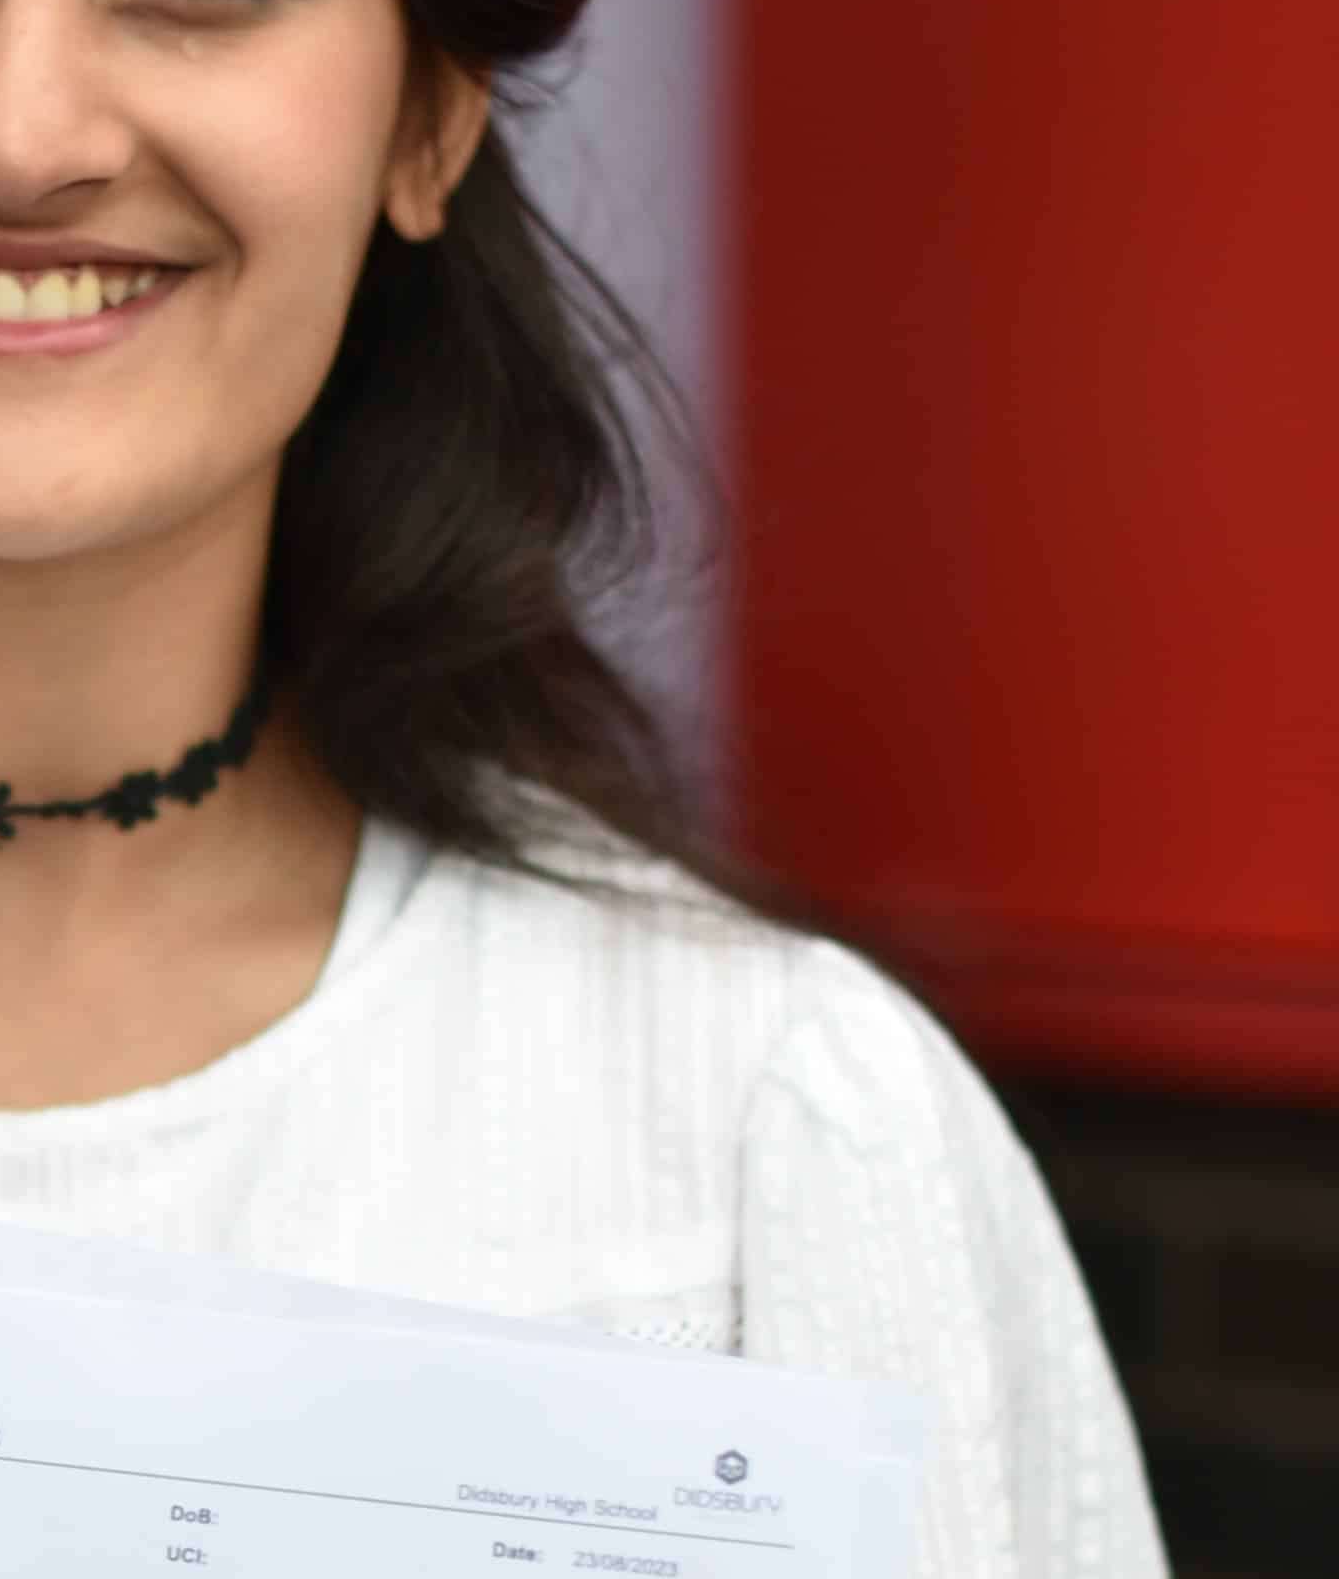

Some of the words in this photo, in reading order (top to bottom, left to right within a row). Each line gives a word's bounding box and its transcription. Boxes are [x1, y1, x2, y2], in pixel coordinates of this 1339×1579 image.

[456, 1483, 539, 1511] Didsbury
[545, 1493, 589, 1518] High
[594, 1499, 659, 1521] School
[169, 1504, 220, 1527] DoB:
[166, 1545, 209, 1567] UCI:
[492, 1541, 544, 1562] Date:
